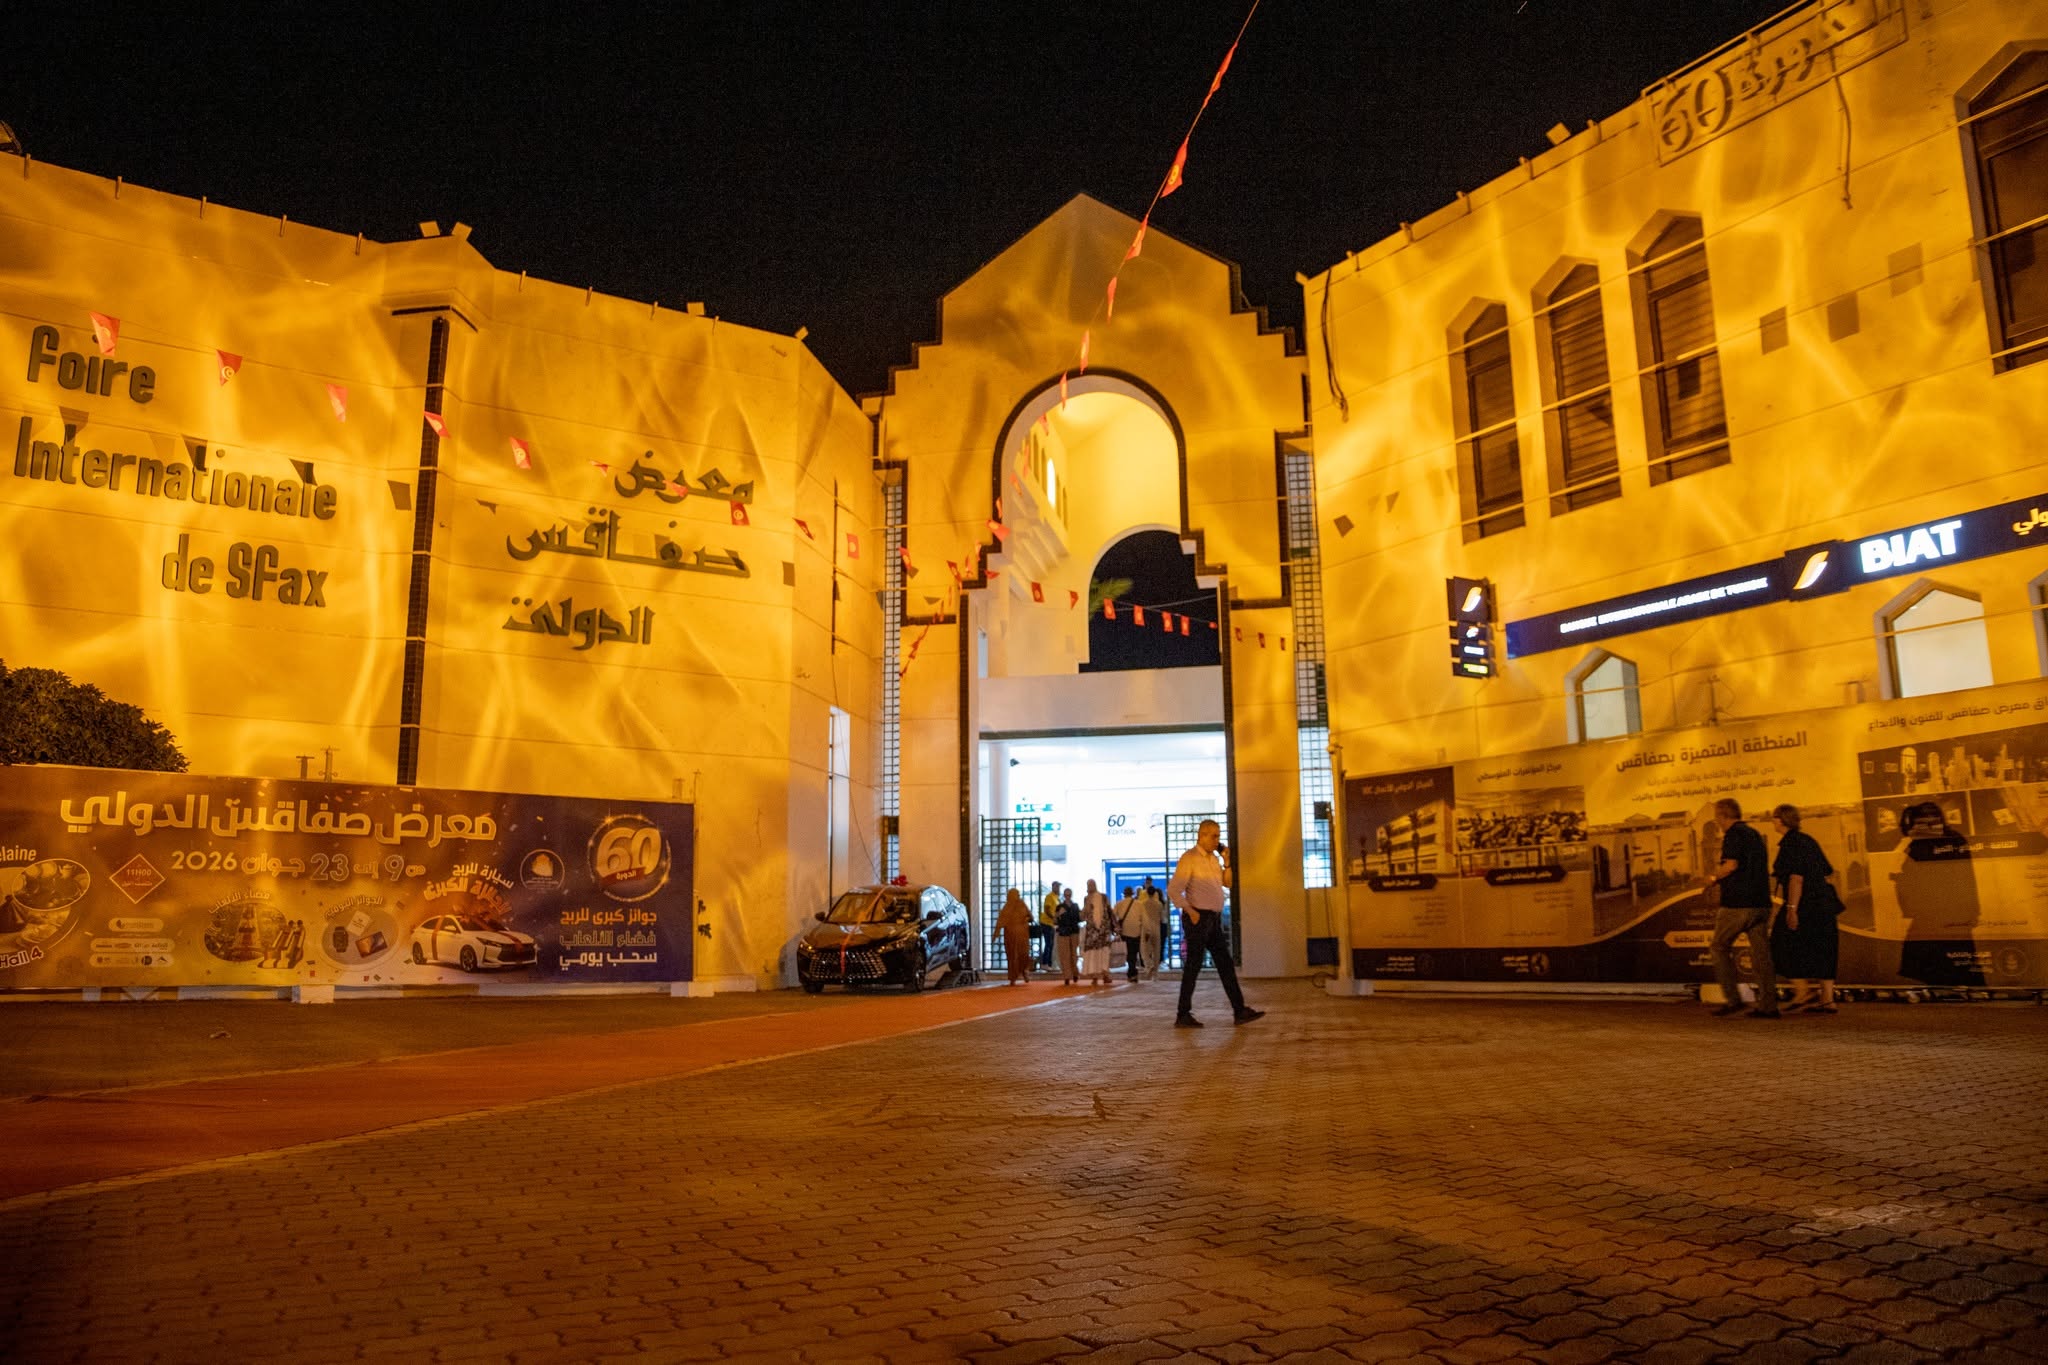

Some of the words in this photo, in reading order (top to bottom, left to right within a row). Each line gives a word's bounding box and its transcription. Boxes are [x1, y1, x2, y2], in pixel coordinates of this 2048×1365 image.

[1661, 67, 1731, 153] 60
[13, 415, 337, 520] Internationale
[614, 449, 754, 505] معرض
[506, 506, 752, 579] صفاقس
[1859, 519, 1963, 574] BIAT
[161, 533, 214, 594] de
[1681, 740, 1738, 765] المتميزة
[1742, 731, 1808, 754] المنطقة
[1616, 752, 1675, 773] بصفاقس
[60, 790, 208, 836] الدولي
[211, 797, 372, 838] صفاقس
[374, 801, 498, 848] معرض
[1107, 814, 1126, 828] 60
[0, 845, 37, 862] laine
[171, 850, 237, 871] 2026
[596, 826, 662, 878] 60
[241, 852, 305, 878] جوان
[310, 853, 349, 881] 23
[384, 854, 404, 881] 9
[452, 861, 479, 877] للربح
[480, 863, 514, 889] سيارة
[616, 870, 637, 881] الدورة
[560, 907, 590, 925] للربح
[593, 908, 624, 925] كبرى
[627, 908, 657, 925] جوائز
[617, 930, 656, 947] فضاء
[30, 945, 44, 961] 4
[559, 951, 603, 971] يومي
[607, 951, 657, 967] سحب
